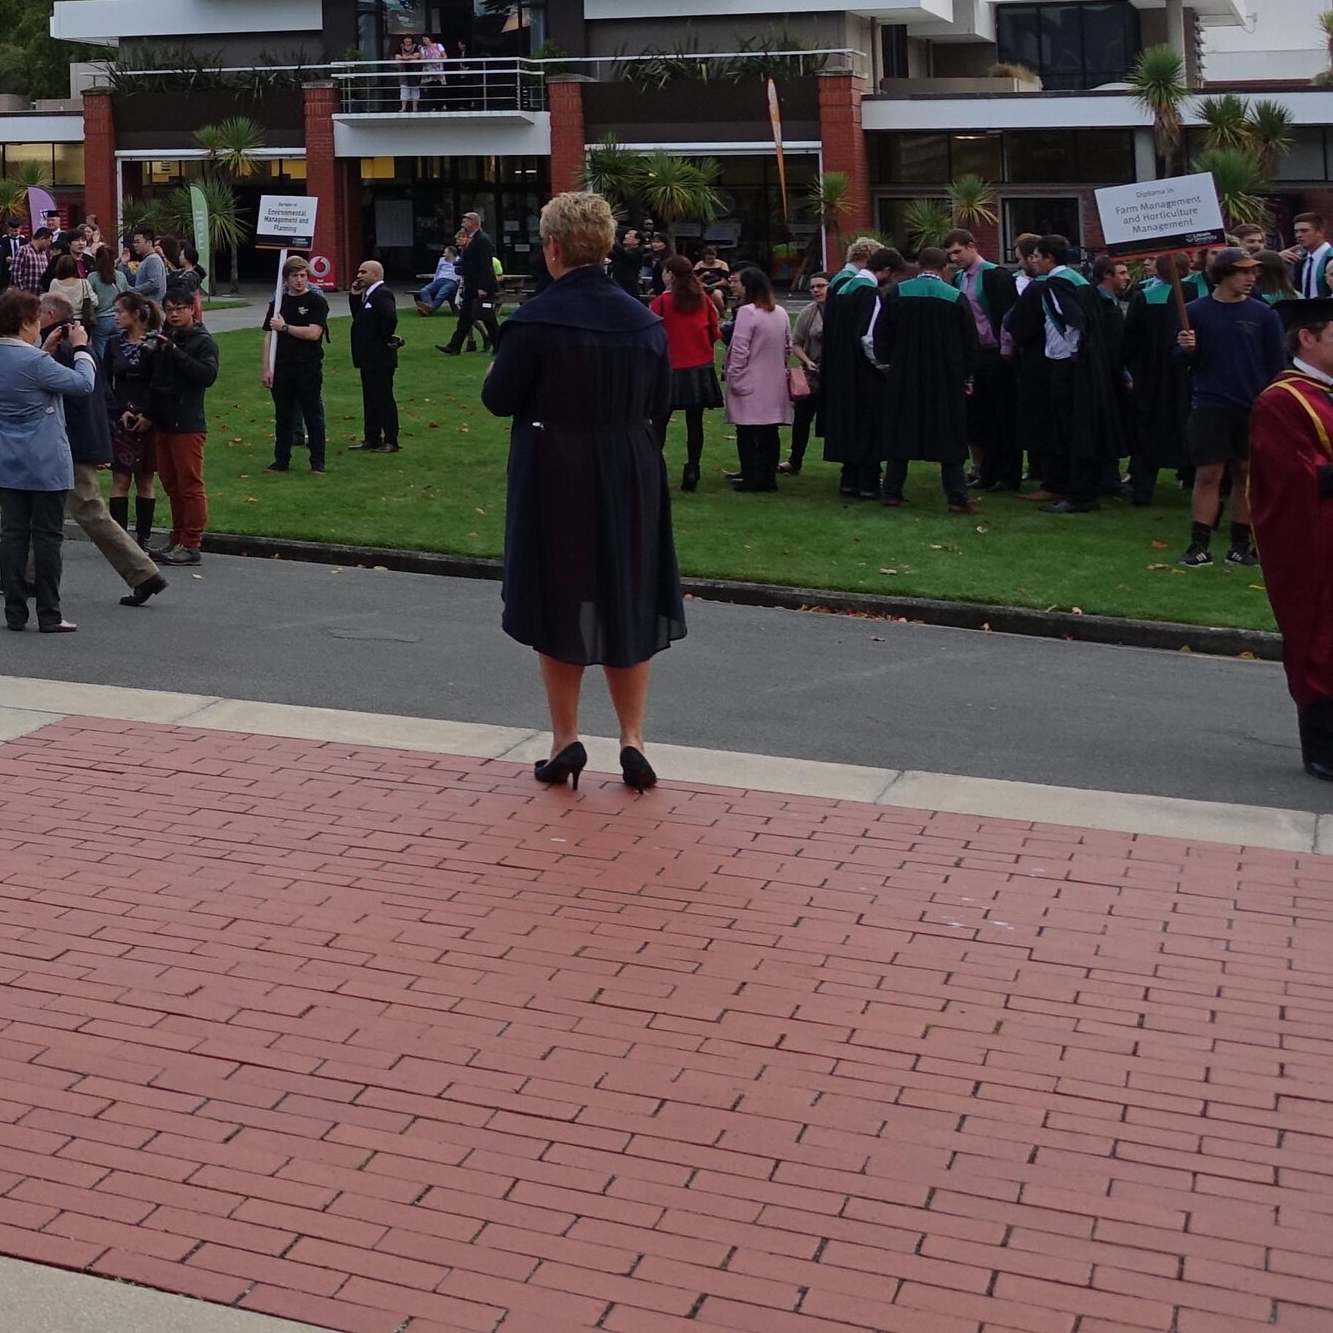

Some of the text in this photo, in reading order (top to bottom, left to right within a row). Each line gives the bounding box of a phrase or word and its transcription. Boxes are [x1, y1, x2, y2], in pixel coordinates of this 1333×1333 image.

[1115, 194, 1202, 215] Farm Management
[263, 216, 298, 225] Management
[1122, 206, 1199, 225] and Horticulture
[273, 224, 297, 234] Planning
[1131, 218, 1193, 234] Management
